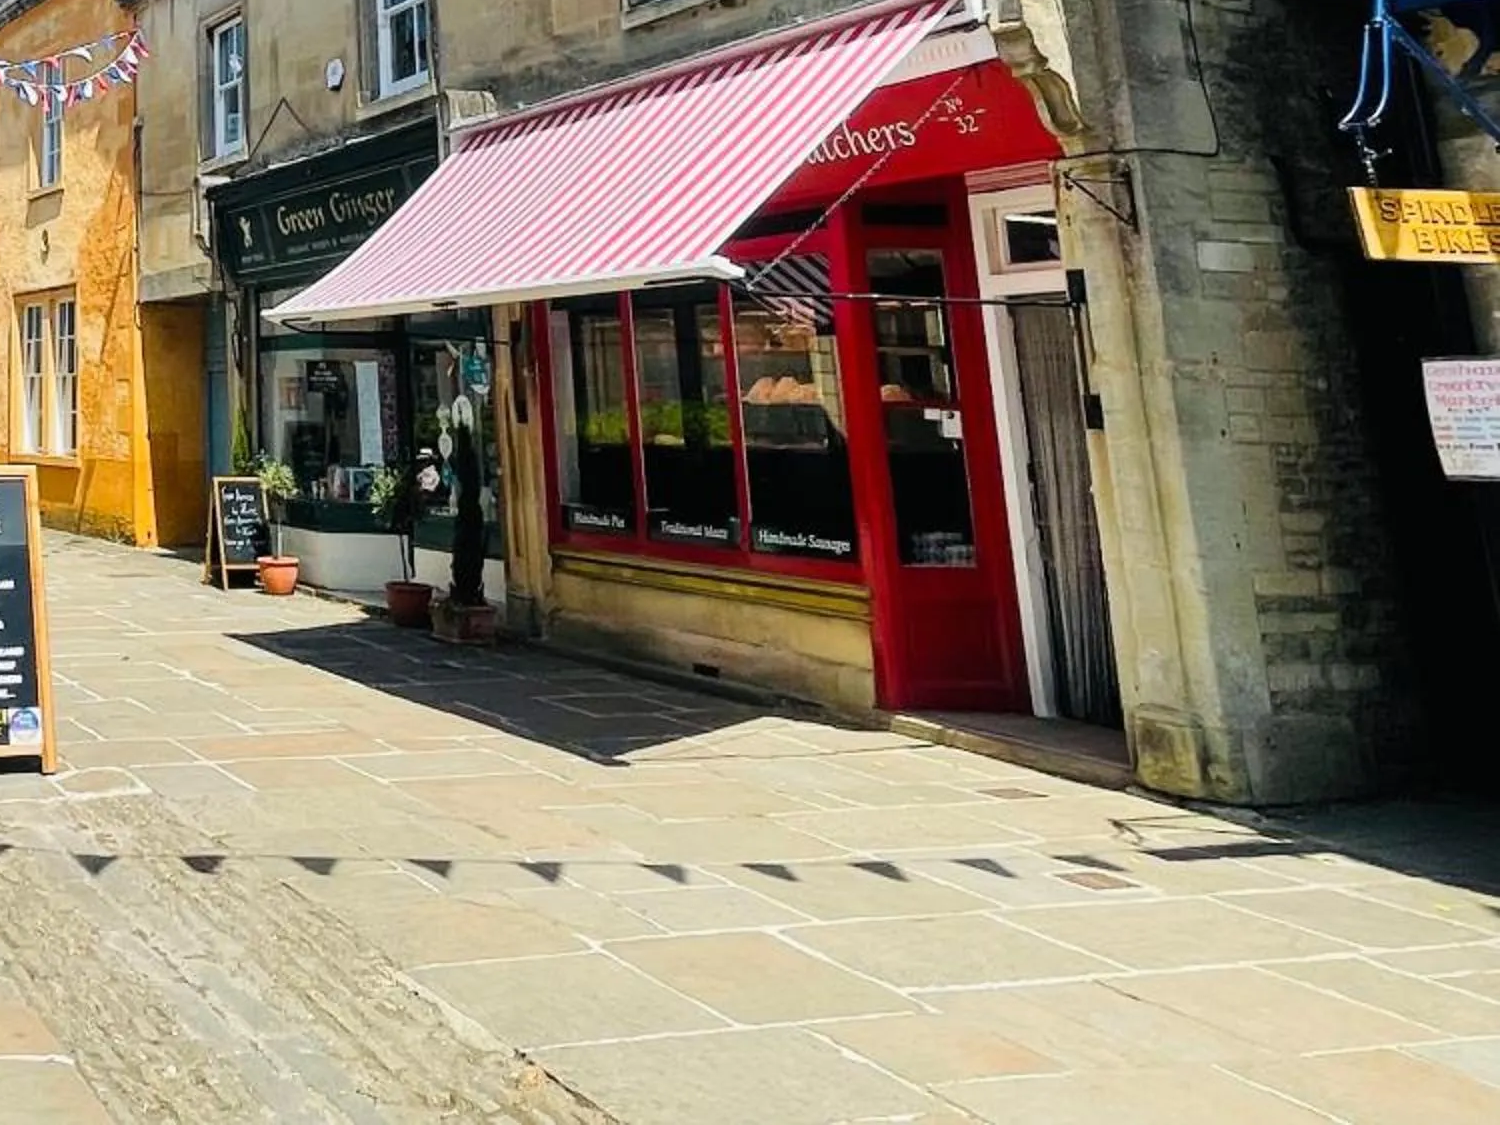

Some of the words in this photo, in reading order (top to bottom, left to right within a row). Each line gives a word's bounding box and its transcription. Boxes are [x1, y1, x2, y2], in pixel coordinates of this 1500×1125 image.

[807, 118, 916, 164] utchers
[954, 114, 979, 134] 32
[277, 205, 326, 236] Green
[329, 186, 395, 226] Ginger
[758, 529, 807, 546] Handmade
[807, 534, 851, 555] Sausages
